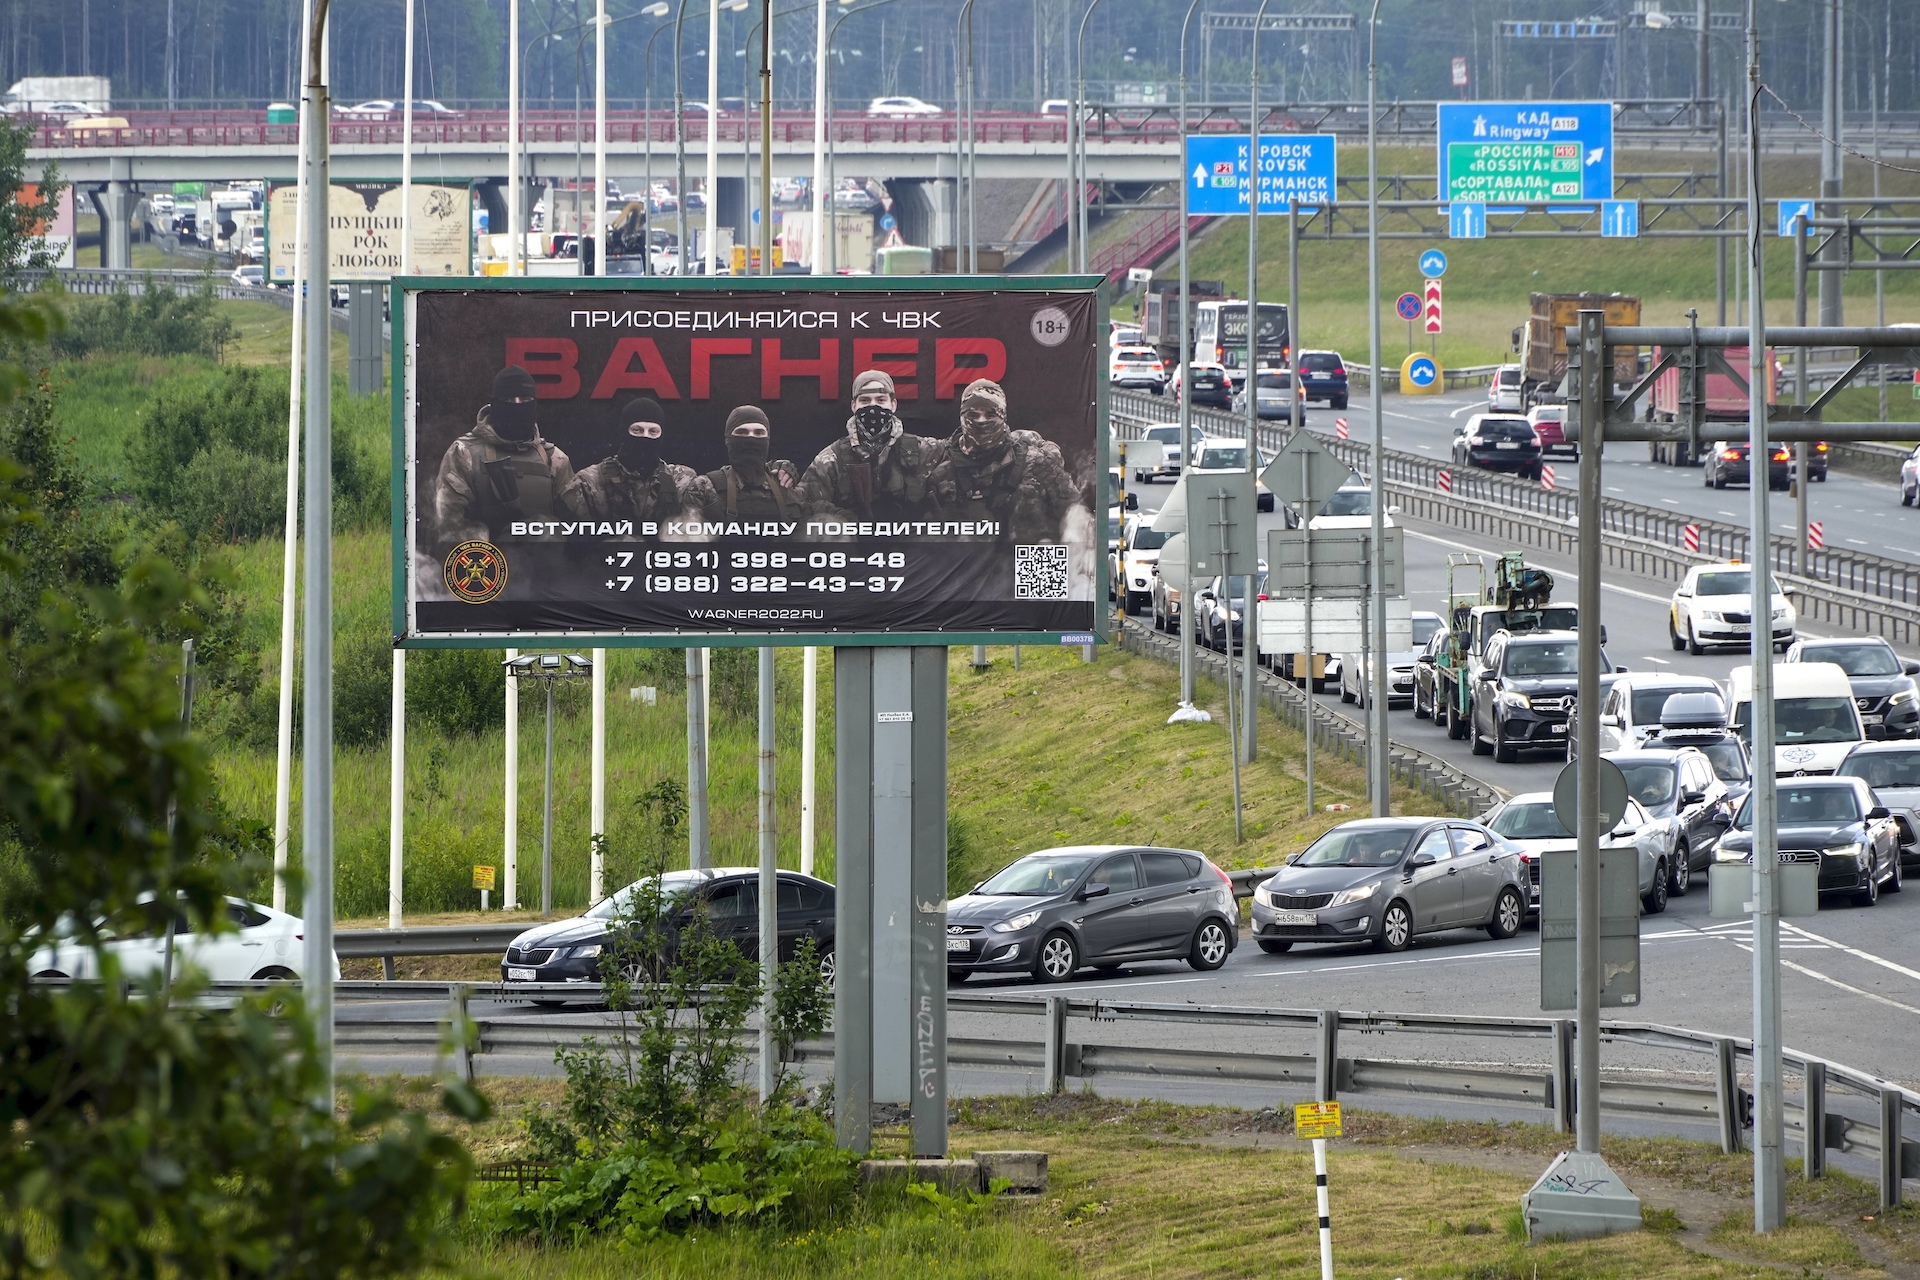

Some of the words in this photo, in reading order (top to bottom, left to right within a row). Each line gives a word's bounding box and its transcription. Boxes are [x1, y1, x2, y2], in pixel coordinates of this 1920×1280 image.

[1517, 111, 1550, 126] КАД
[1554, 119, 1577, 130] А118
[1490, 125, 1549, 141] Ringway
[1238, 144, 1312, 158] КРОВСК
[1474, 145, 1550, 158] «РОССИЯ»
[1238, 158, 1307, 172] KROVSK
[1469, 159, 1550, 172] «ROSSIYA»
[1451, 176, 1550, 189] «СОРТАВАЛА»
[1555, 184, 1577, 194] А121
[354, 235, 388, 249] РОК
[332, 254, 403, 268] ЛЮБОВ
[571, 310, 838, 331] ПРИСОЕДИНЯЙСЯ
[851, 312, 870, 328] К
[882, 312, 941, 328] ЧВК
[1035, 320, 1066, 334] 18+
[505, 336, 1007, 400] ВАГНЕР
[511, 520, 633, 536] ВСТУПАЙ
[642, 522, 658, 536] В
[668, 522, 798, 537] КОМАНДУ
[806, 520, 1000, 537] ПОБЕДИТЕЛЕЙ!
[605, 552, 634, 568] +7
[645, 550, 720, 569] (931)
[730, 552, 906, 568] 398-08-48
[605, 576, 634, 592] +7
[645, 574, 720, 593] (988)
[730, 576, 906, 592] 322-43-37
[687, 609, 824, 620] WAGNER2022.RU
